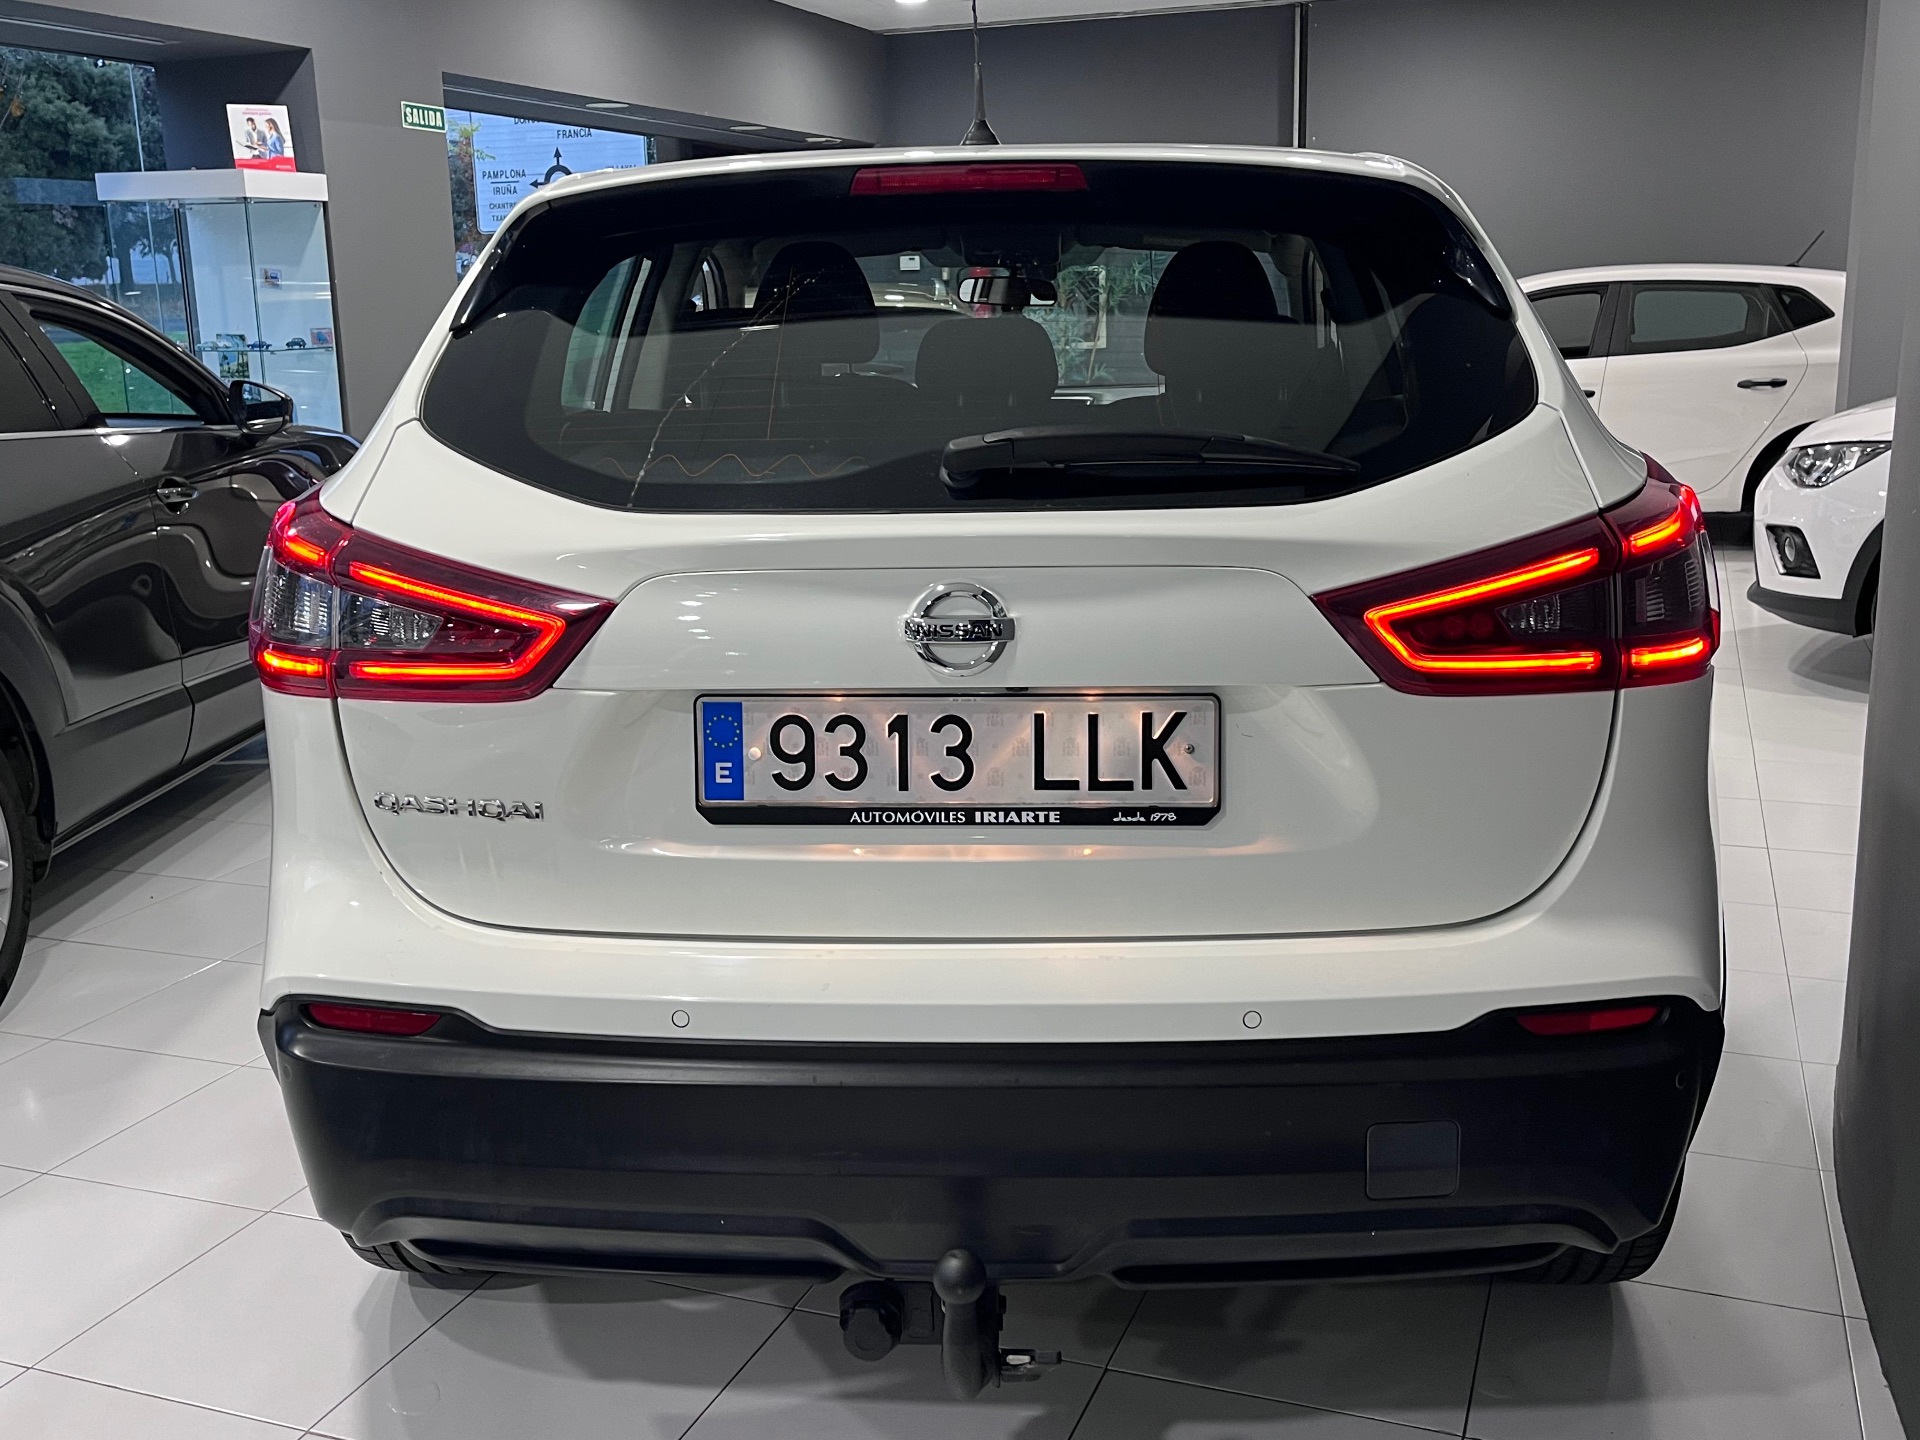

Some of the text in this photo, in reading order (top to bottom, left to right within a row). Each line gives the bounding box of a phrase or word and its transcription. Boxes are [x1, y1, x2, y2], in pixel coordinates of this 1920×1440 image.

[405, 106, 443, 128] SALIDA
[556, 128, 593, 139] FRANCIA
[482, 169, 526, 180] PAMPLONA
[492, 184, 518, 195] IRUÑA
[917, 624, 1004, 639] NISSAN
[768, 711, 1189, 793] 9313 LLK
[715, 762, 733, 784] E
[373, 791, 544, 821] QASHQAI
[849, 810, 966, 823] AUTOMÓVILES
[974, 811, 1061, 824] IRIARTE
[1150, 812, 1177, 822] 1978
